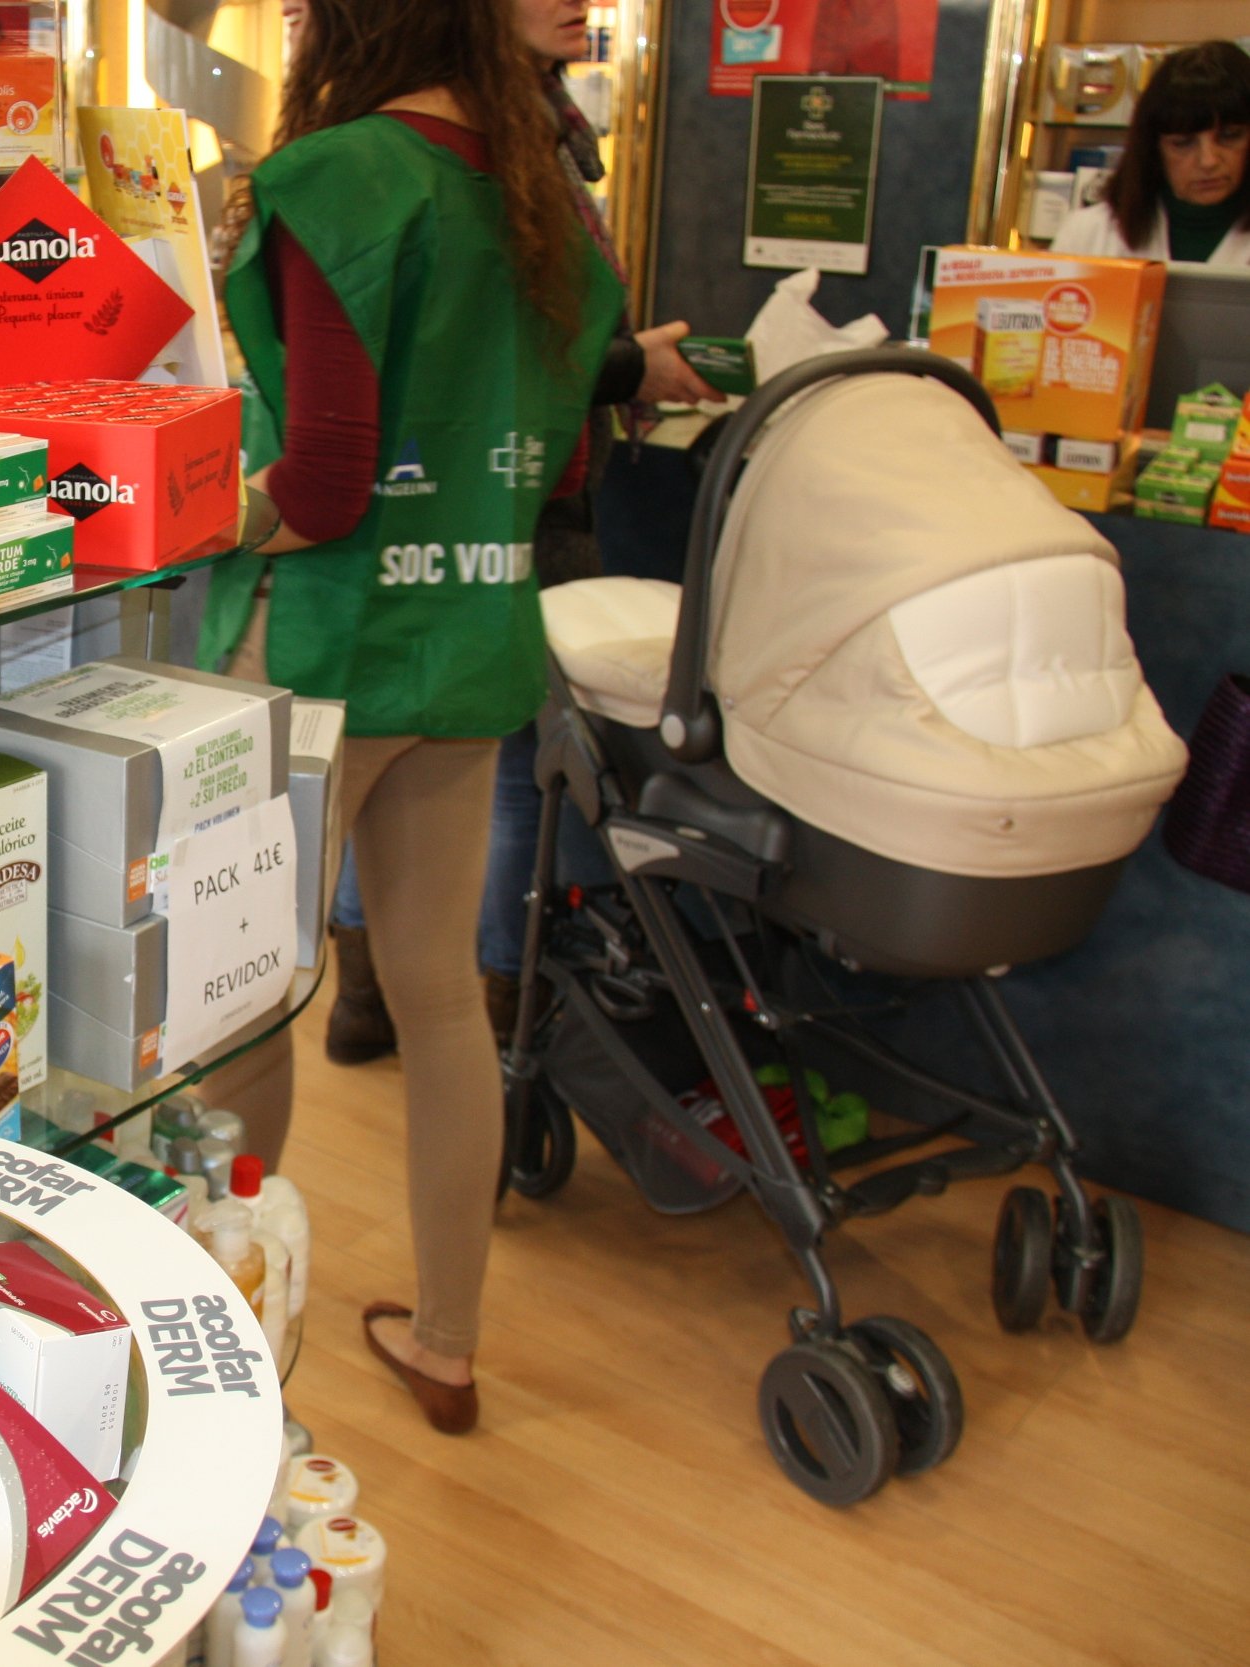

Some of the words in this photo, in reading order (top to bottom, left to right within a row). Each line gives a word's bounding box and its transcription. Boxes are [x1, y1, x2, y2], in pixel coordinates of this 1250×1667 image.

[46, 287, 85, 300] únicas
[47, 306, 83, 326] placer
[47, 474, 136, 505] uanola
[379, 542, 446, 586] SOC
[195, 728, 243, 755] MULTIPLICAMOS
[194, 864, 240, 905] PACK
[253, 842, 284, 875] 41€
[204, 947, 281, 1005] REVIDOX
[140, 1298, 216, 1398] DERM
[192, 1294, 263, 1398] acofar
[36, 1492, 83, 1538] actavis
[12, 1528, 170, 1656] DERM
